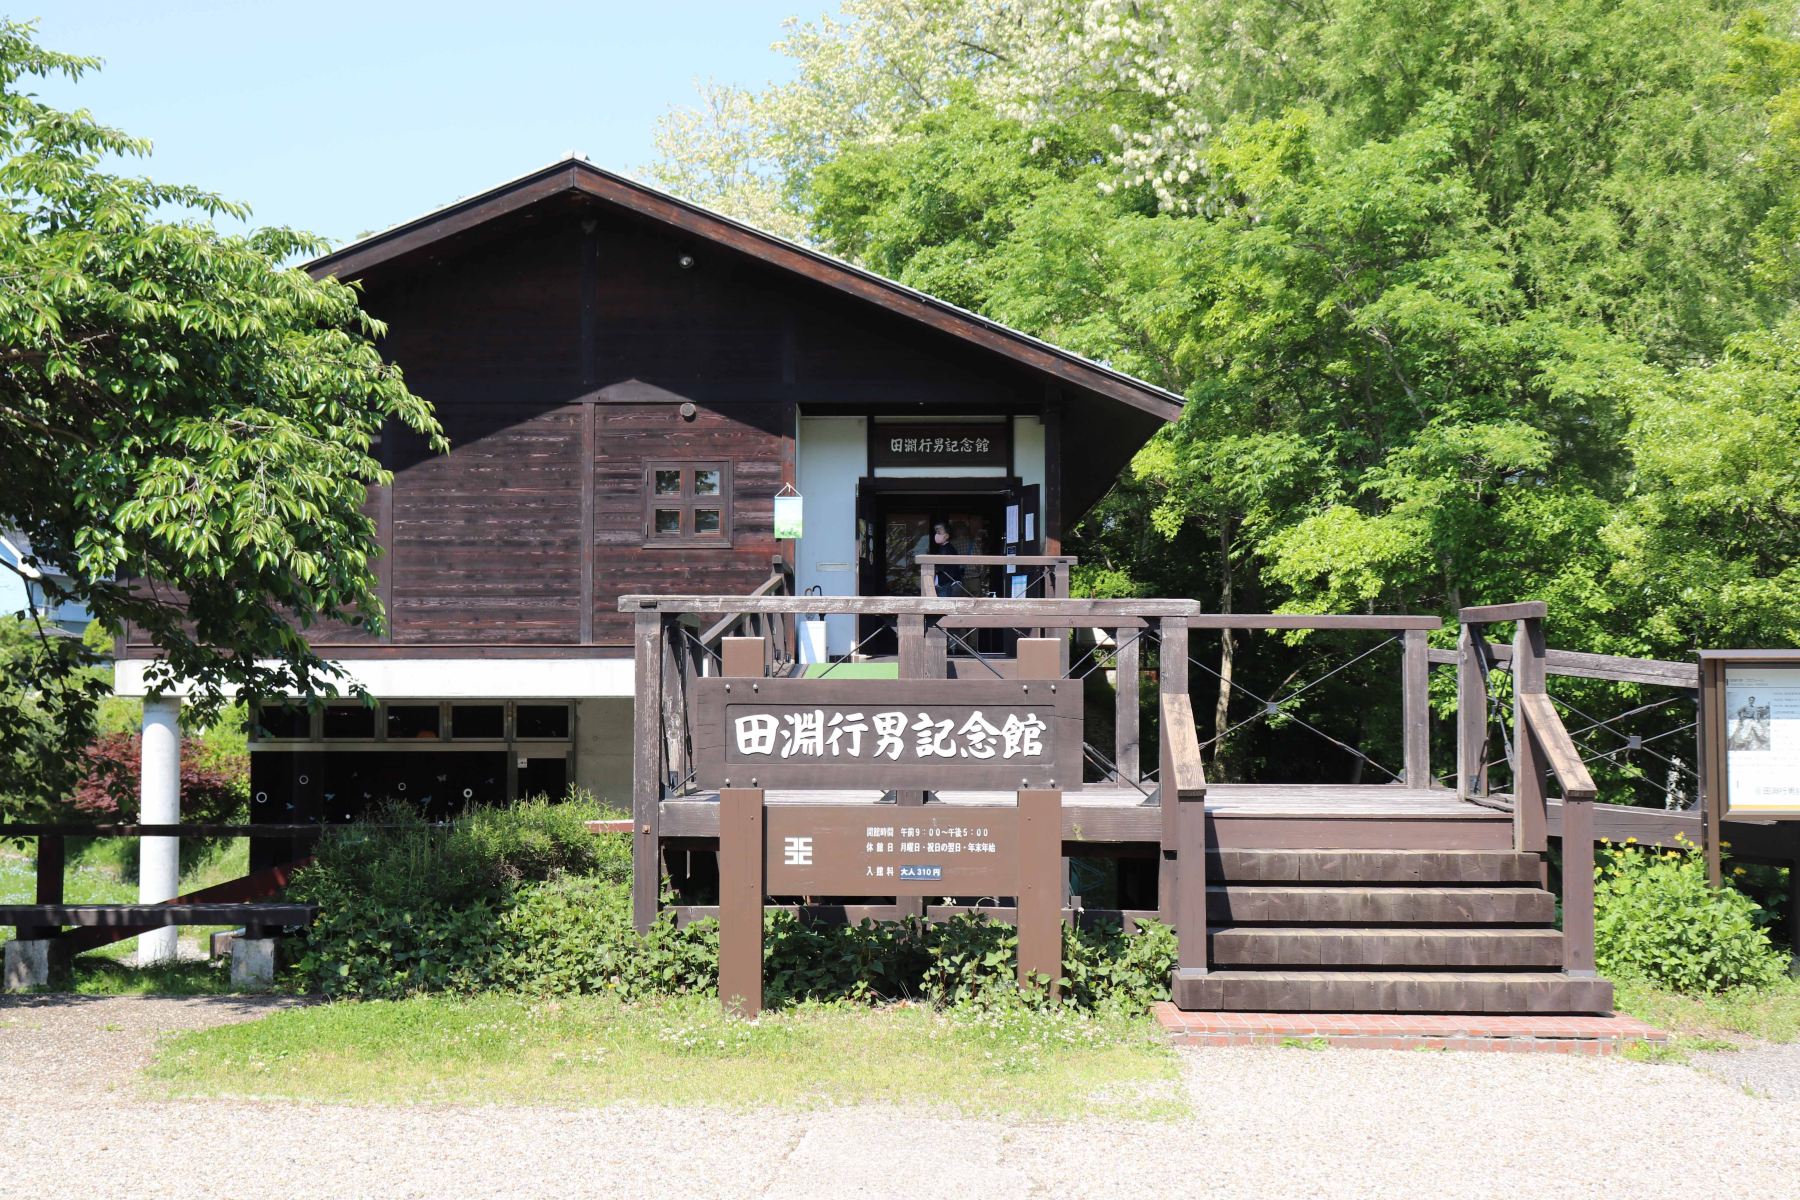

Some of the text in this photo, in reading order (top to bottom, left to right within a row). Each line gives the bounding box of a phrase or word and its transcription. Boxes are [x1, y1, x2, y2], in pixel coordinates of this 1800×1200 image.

[734, 709, 1047, 761] 田淵行男記念館
